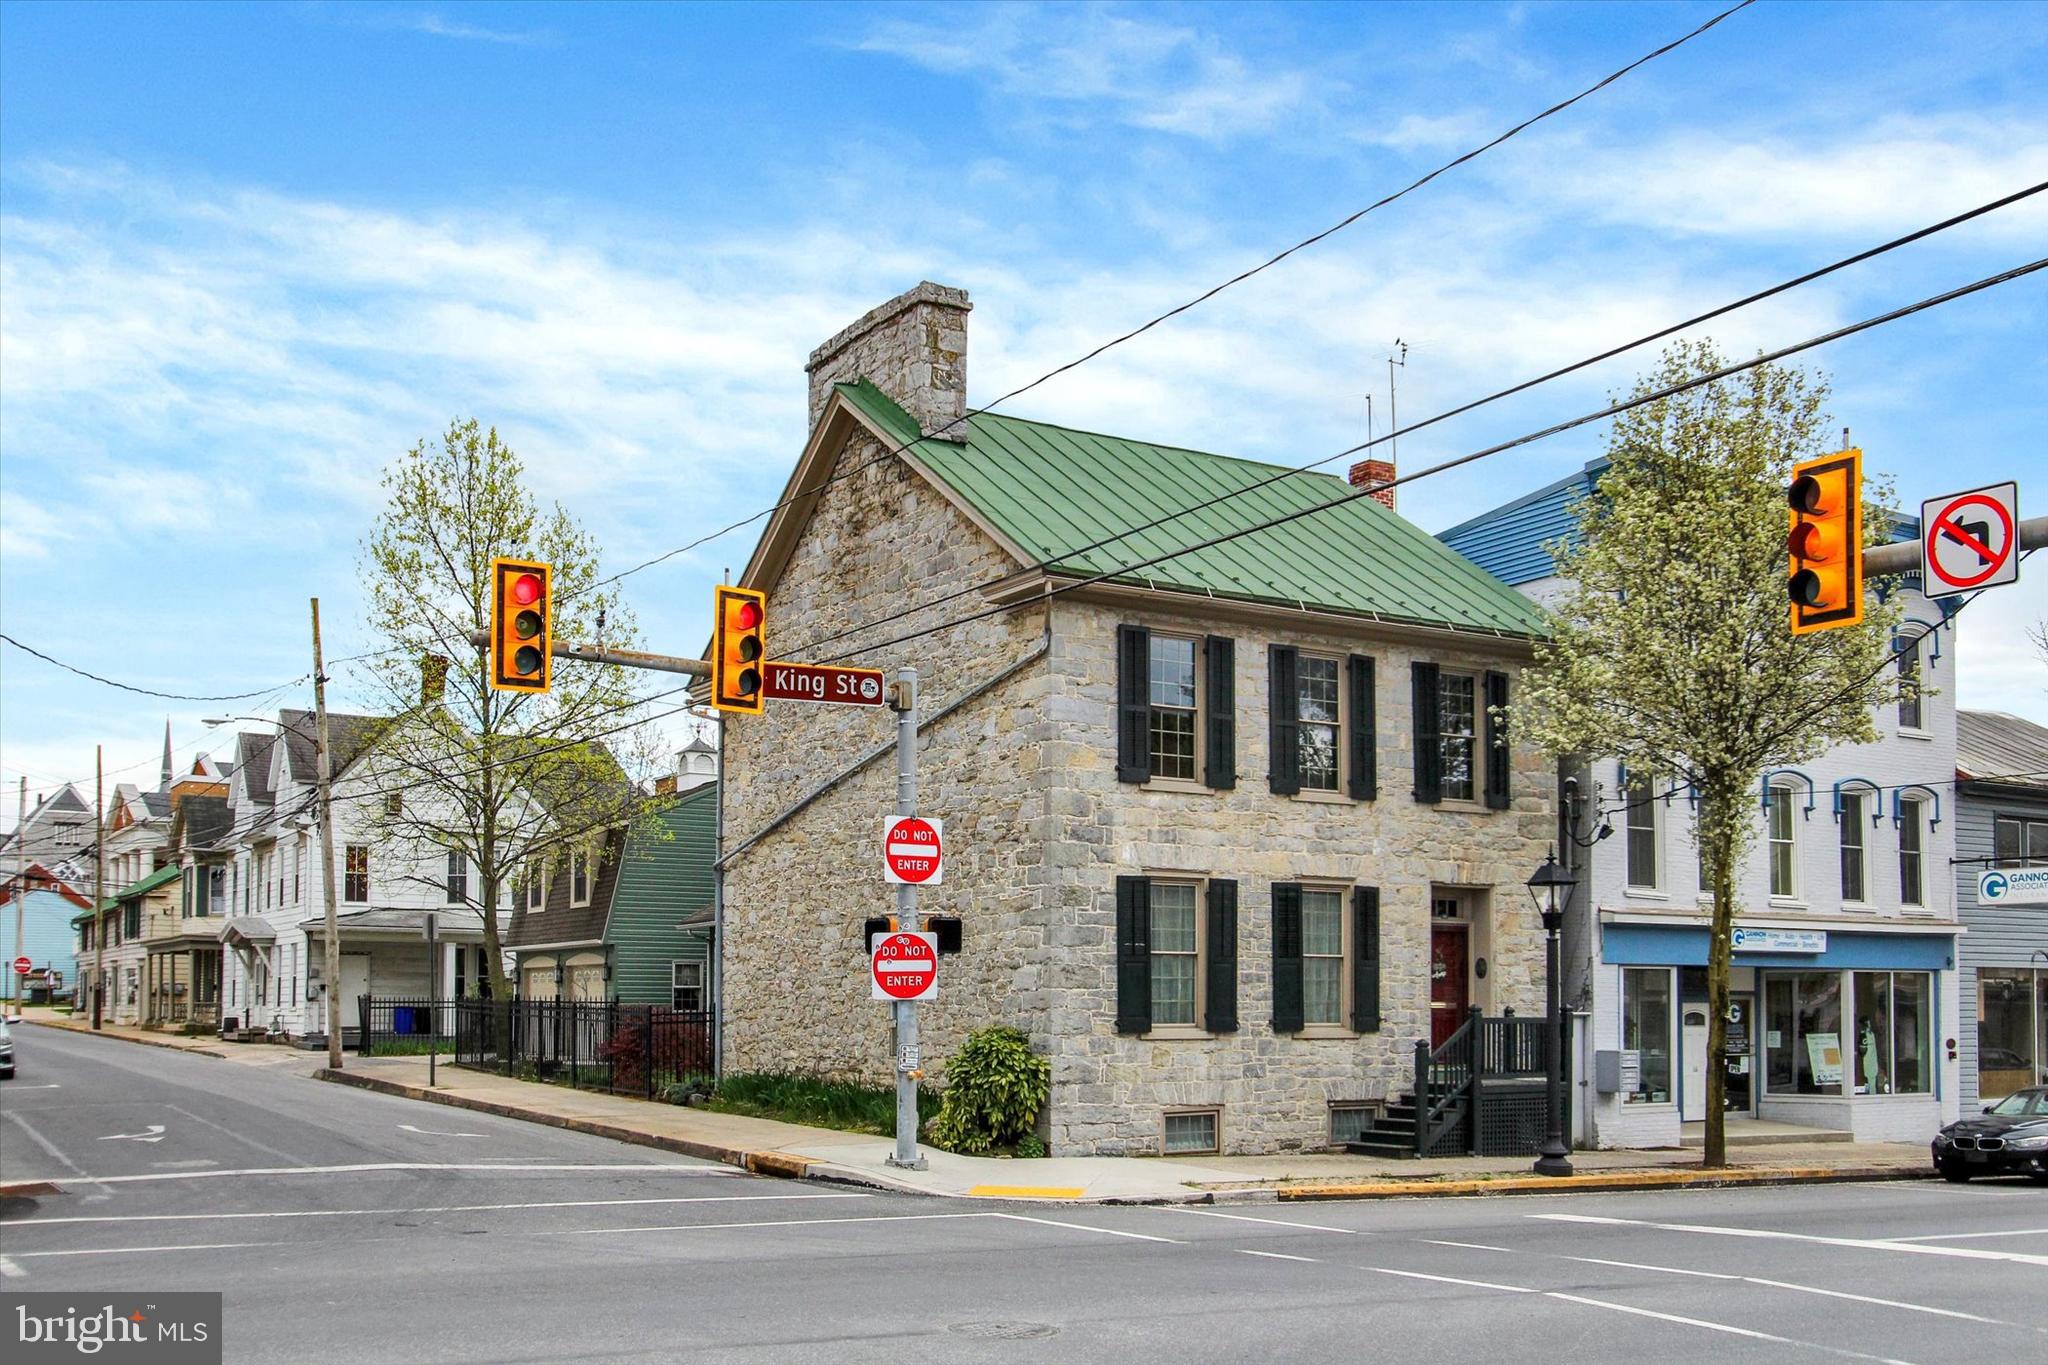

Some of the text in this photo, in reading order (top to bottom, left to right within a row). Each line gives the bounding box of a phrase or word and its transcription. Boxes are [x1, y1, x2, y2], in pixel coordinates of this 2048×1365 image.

[775, 669, 857, 698] King St
[894, 829, 933, 841] DO NOT
[897, 859, 929, 871] ENTER
[882, 945, 927, 957] DO NOT
[887, 975, 923, 987] ENTER
